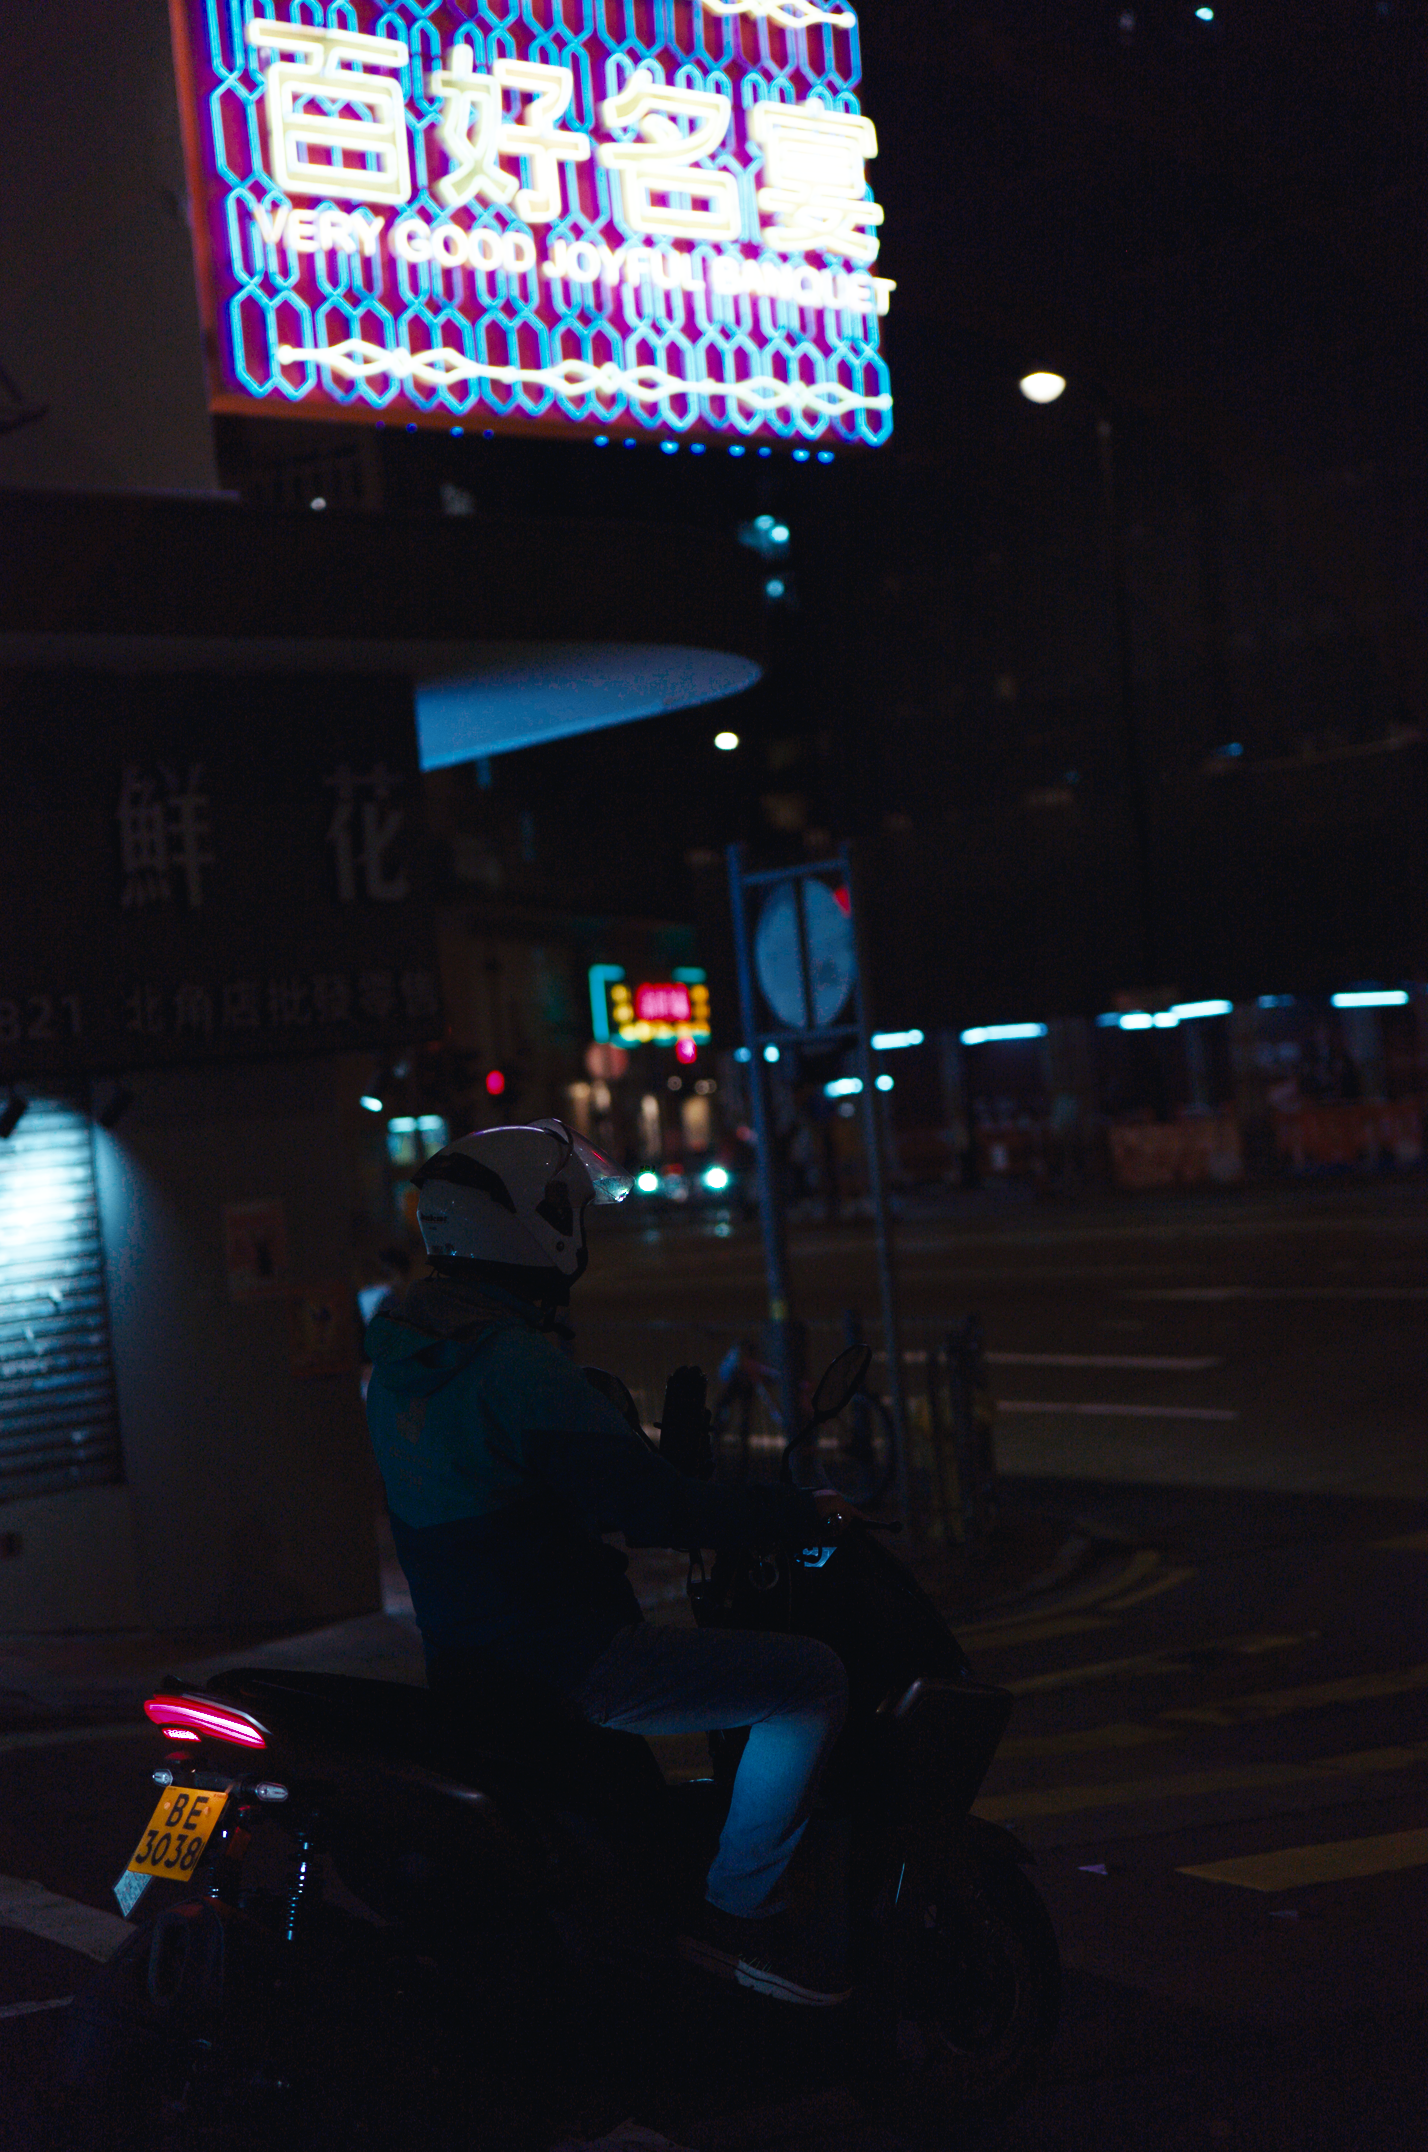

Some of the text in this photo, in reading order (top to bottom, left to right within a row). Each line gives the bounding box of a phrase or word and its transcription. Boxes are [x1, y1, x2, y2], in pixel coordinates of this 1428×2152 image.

[247, 18, 884, 261] 百好名宴
[253, 204, 896, 315] VERY GOOD JOYFUL BANQUET
[118, 763, 410, 908] 鮮花
[135, 1829, 203, 1871] 3038
[165, 1793, 209, 1831] BE
